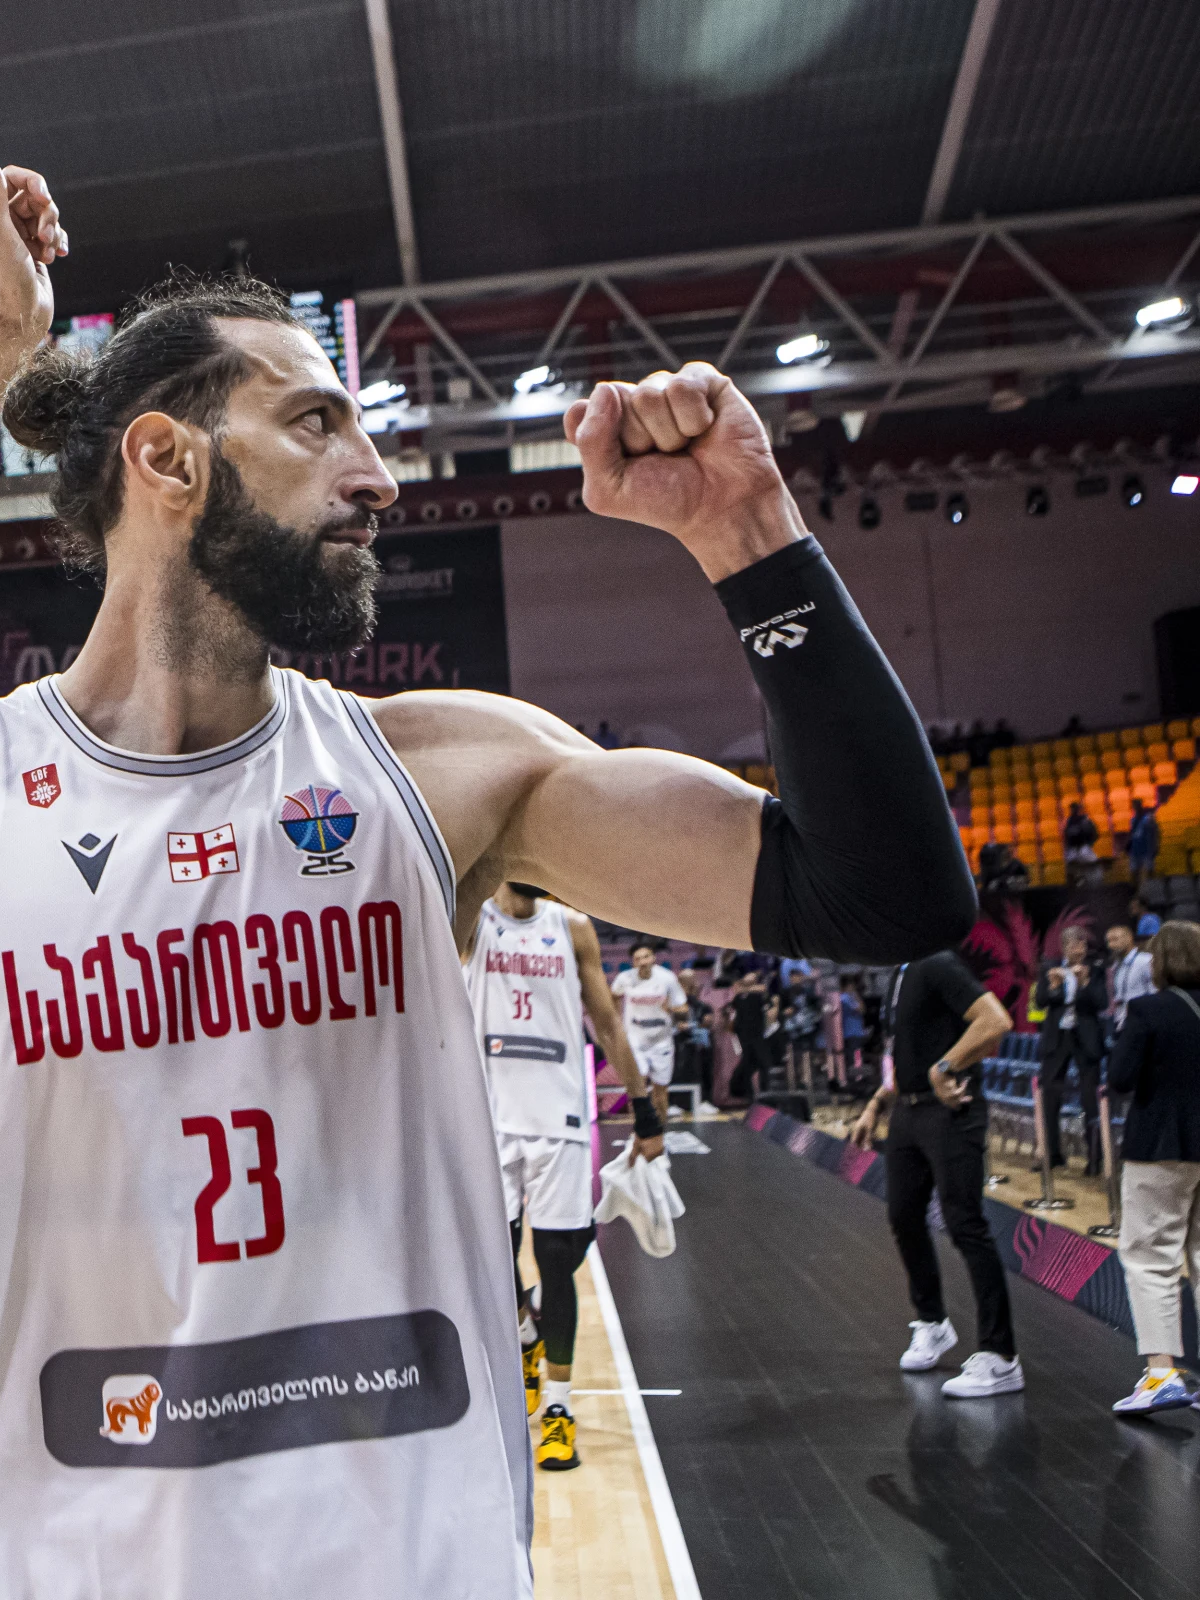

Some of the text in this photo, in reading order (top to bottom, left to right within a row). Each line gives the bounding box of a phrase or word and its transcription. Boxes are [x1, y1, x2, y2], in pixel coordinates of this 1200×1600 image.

[30, 766, 48, 783] GBF
[1, 900, 405, 1066] საქართველო
[511, 989, 534, 1020] 35
[181, 1107, 286, 1265] 23
[165, 1364, 420, 1421] საქართველოს ბანკი
